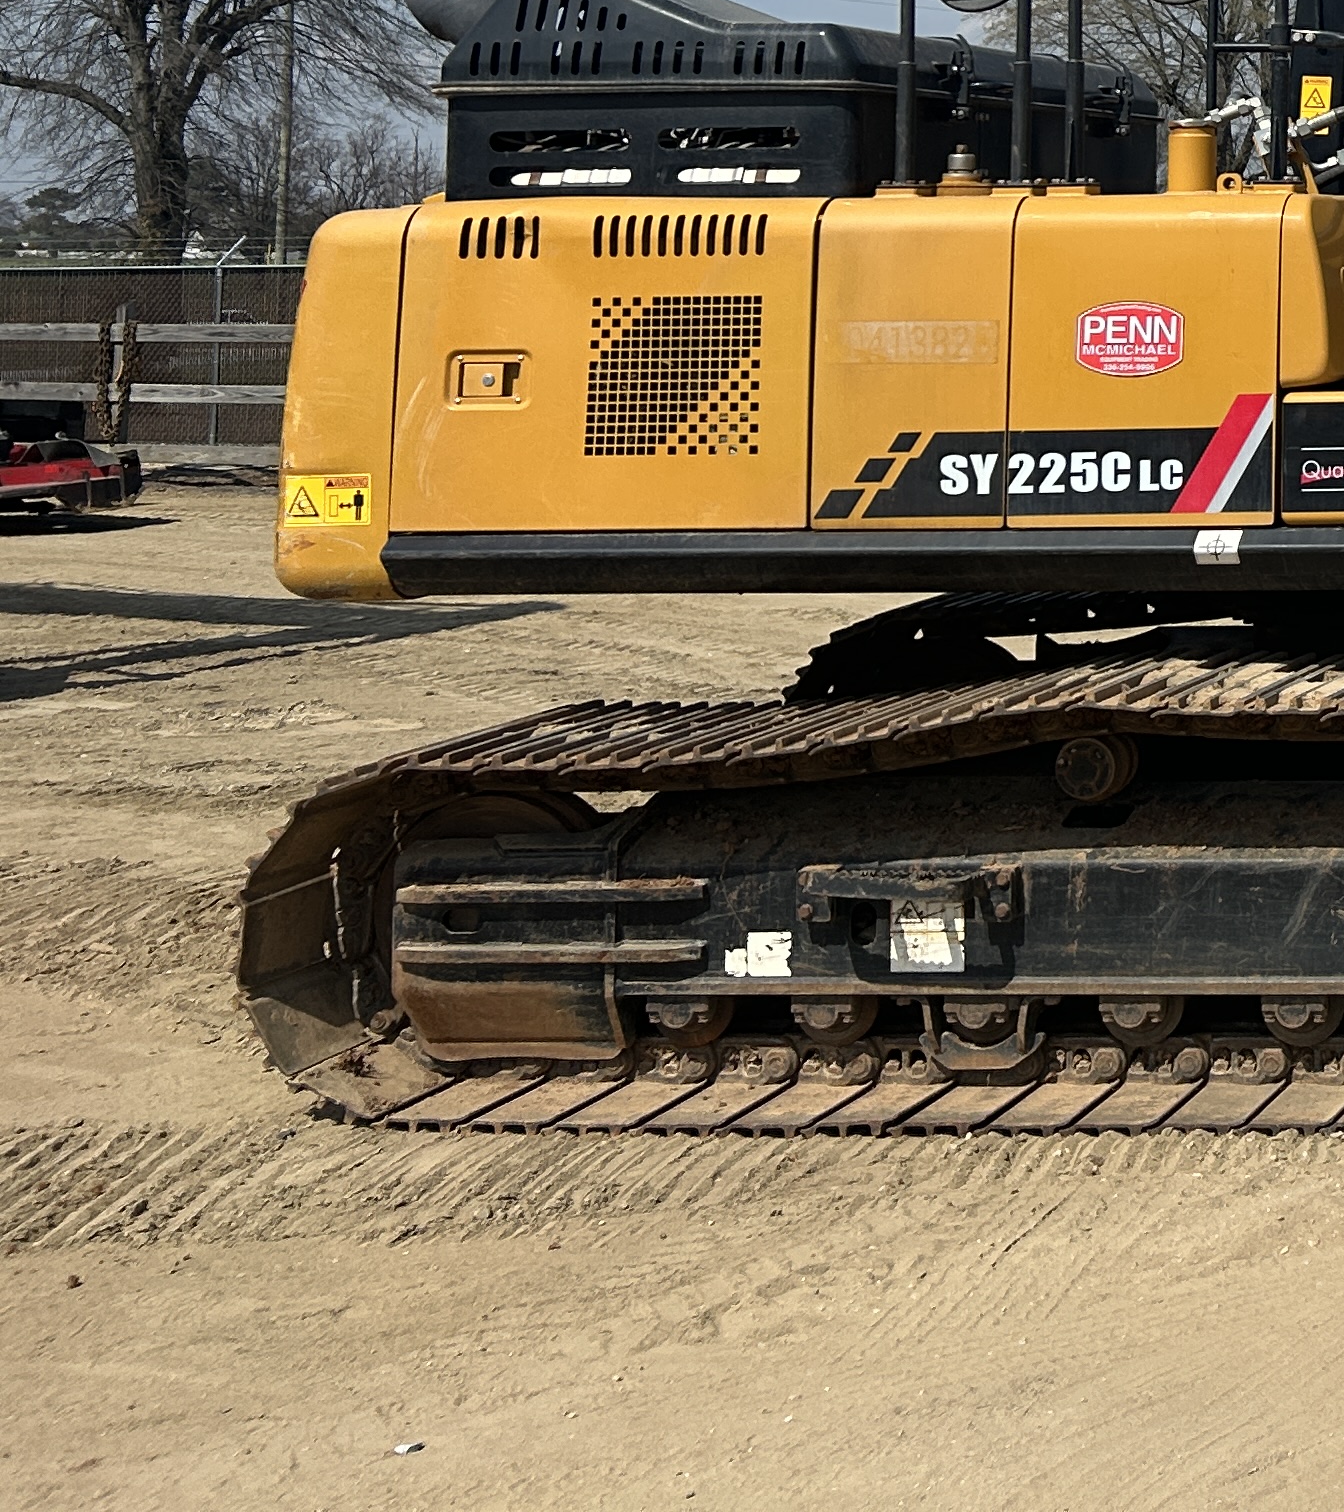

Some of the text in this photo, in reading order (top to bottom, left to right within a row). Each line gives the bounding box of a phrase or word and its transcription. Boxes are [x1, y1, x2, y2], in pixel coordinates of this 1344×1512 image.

[1083, 315, 1178, 344] PENN
[1082, 344, 1176, 356] MCMICHAEL
[939, 453, 998, 495] SY
